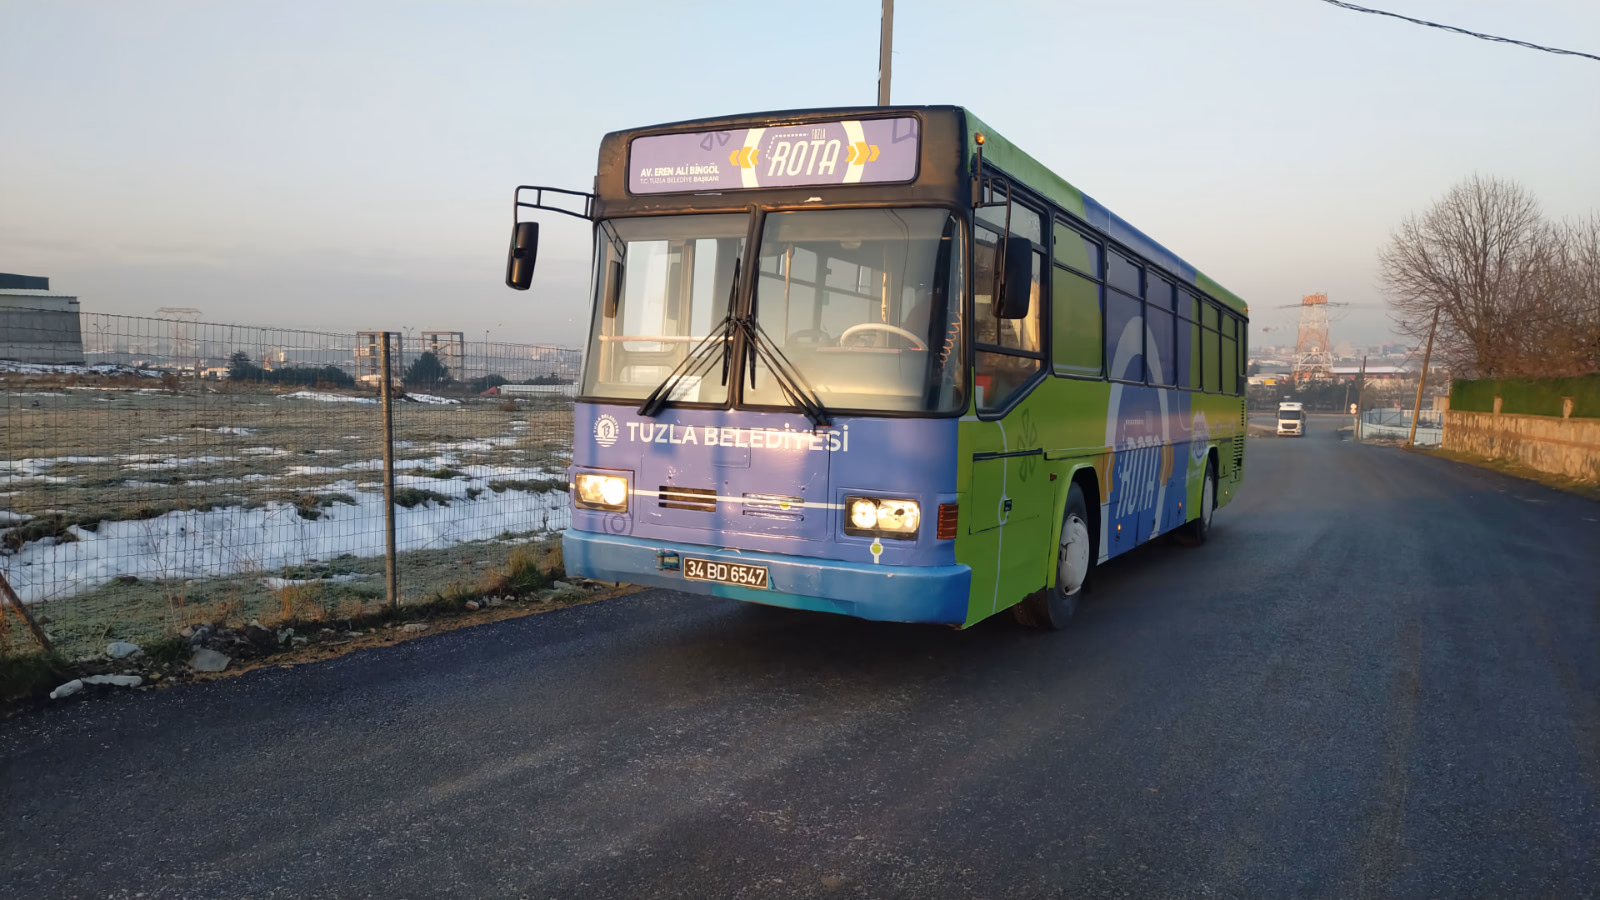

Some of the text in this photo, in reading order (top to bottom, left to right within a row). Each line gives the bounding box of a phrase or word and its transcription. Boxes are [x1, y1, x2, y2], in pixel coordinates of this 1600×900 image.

[767, 139, 841, 176] ROTA
[640, 162, 720, 178] AV. EREN ALİ BİNGÖL
[649, 177, 666, 185] TUZLA
[693, 175, 720, 183] BAŞKANI
[626, 422, 849, 452] TUZLA BELEDİYESİ
[687, 561, 765, 585] 34 BD 6547
